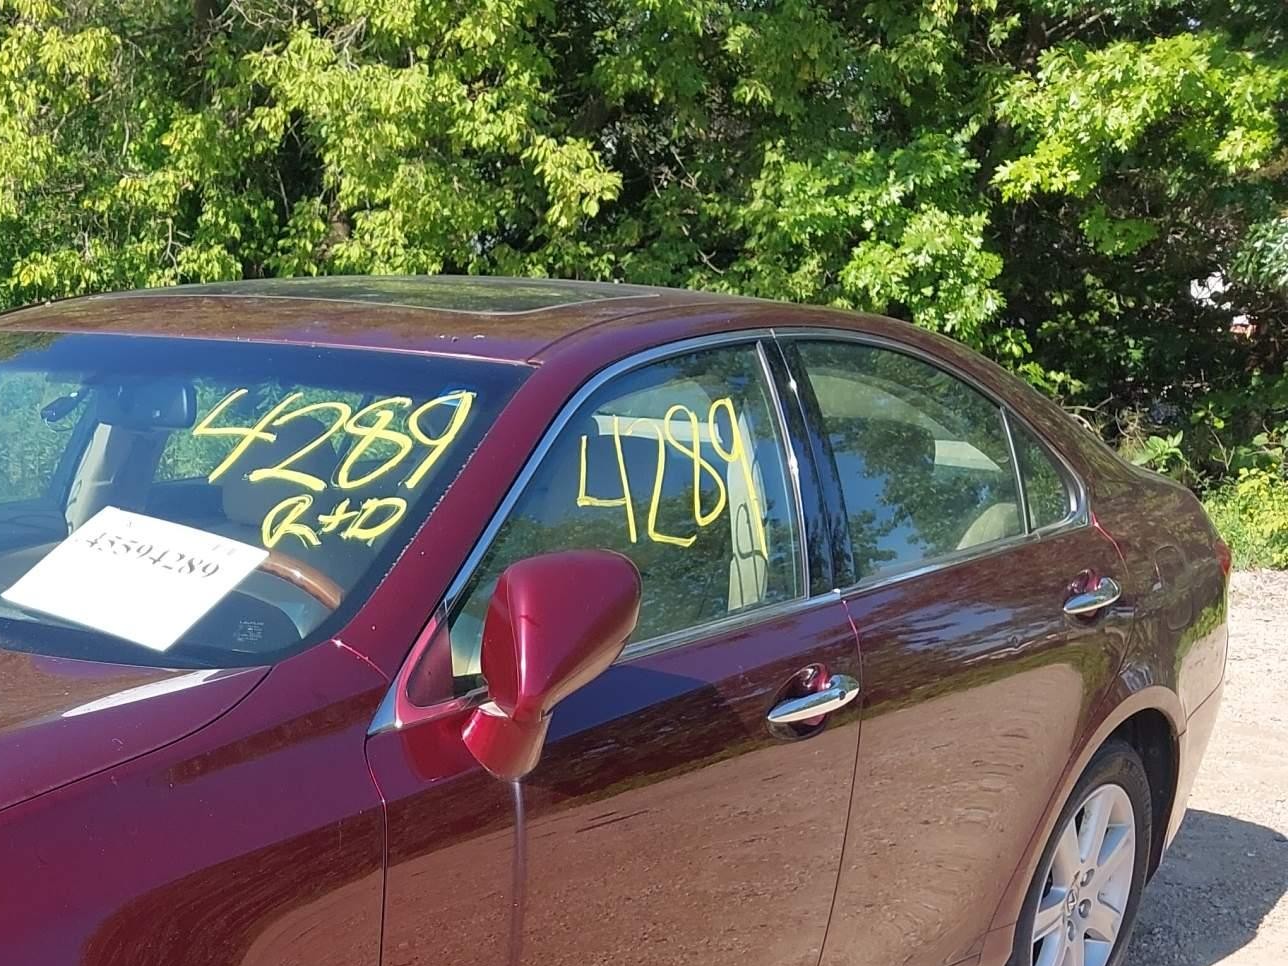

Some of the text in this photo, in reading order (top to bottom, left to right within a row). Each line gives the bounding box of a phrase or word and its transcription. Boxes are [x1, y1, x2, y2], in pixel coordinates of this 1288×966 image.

[192, 388, 478, 491] 4289
[577, 398, 769, 560] 4289
[85, 532, 220, 578] 45594289
